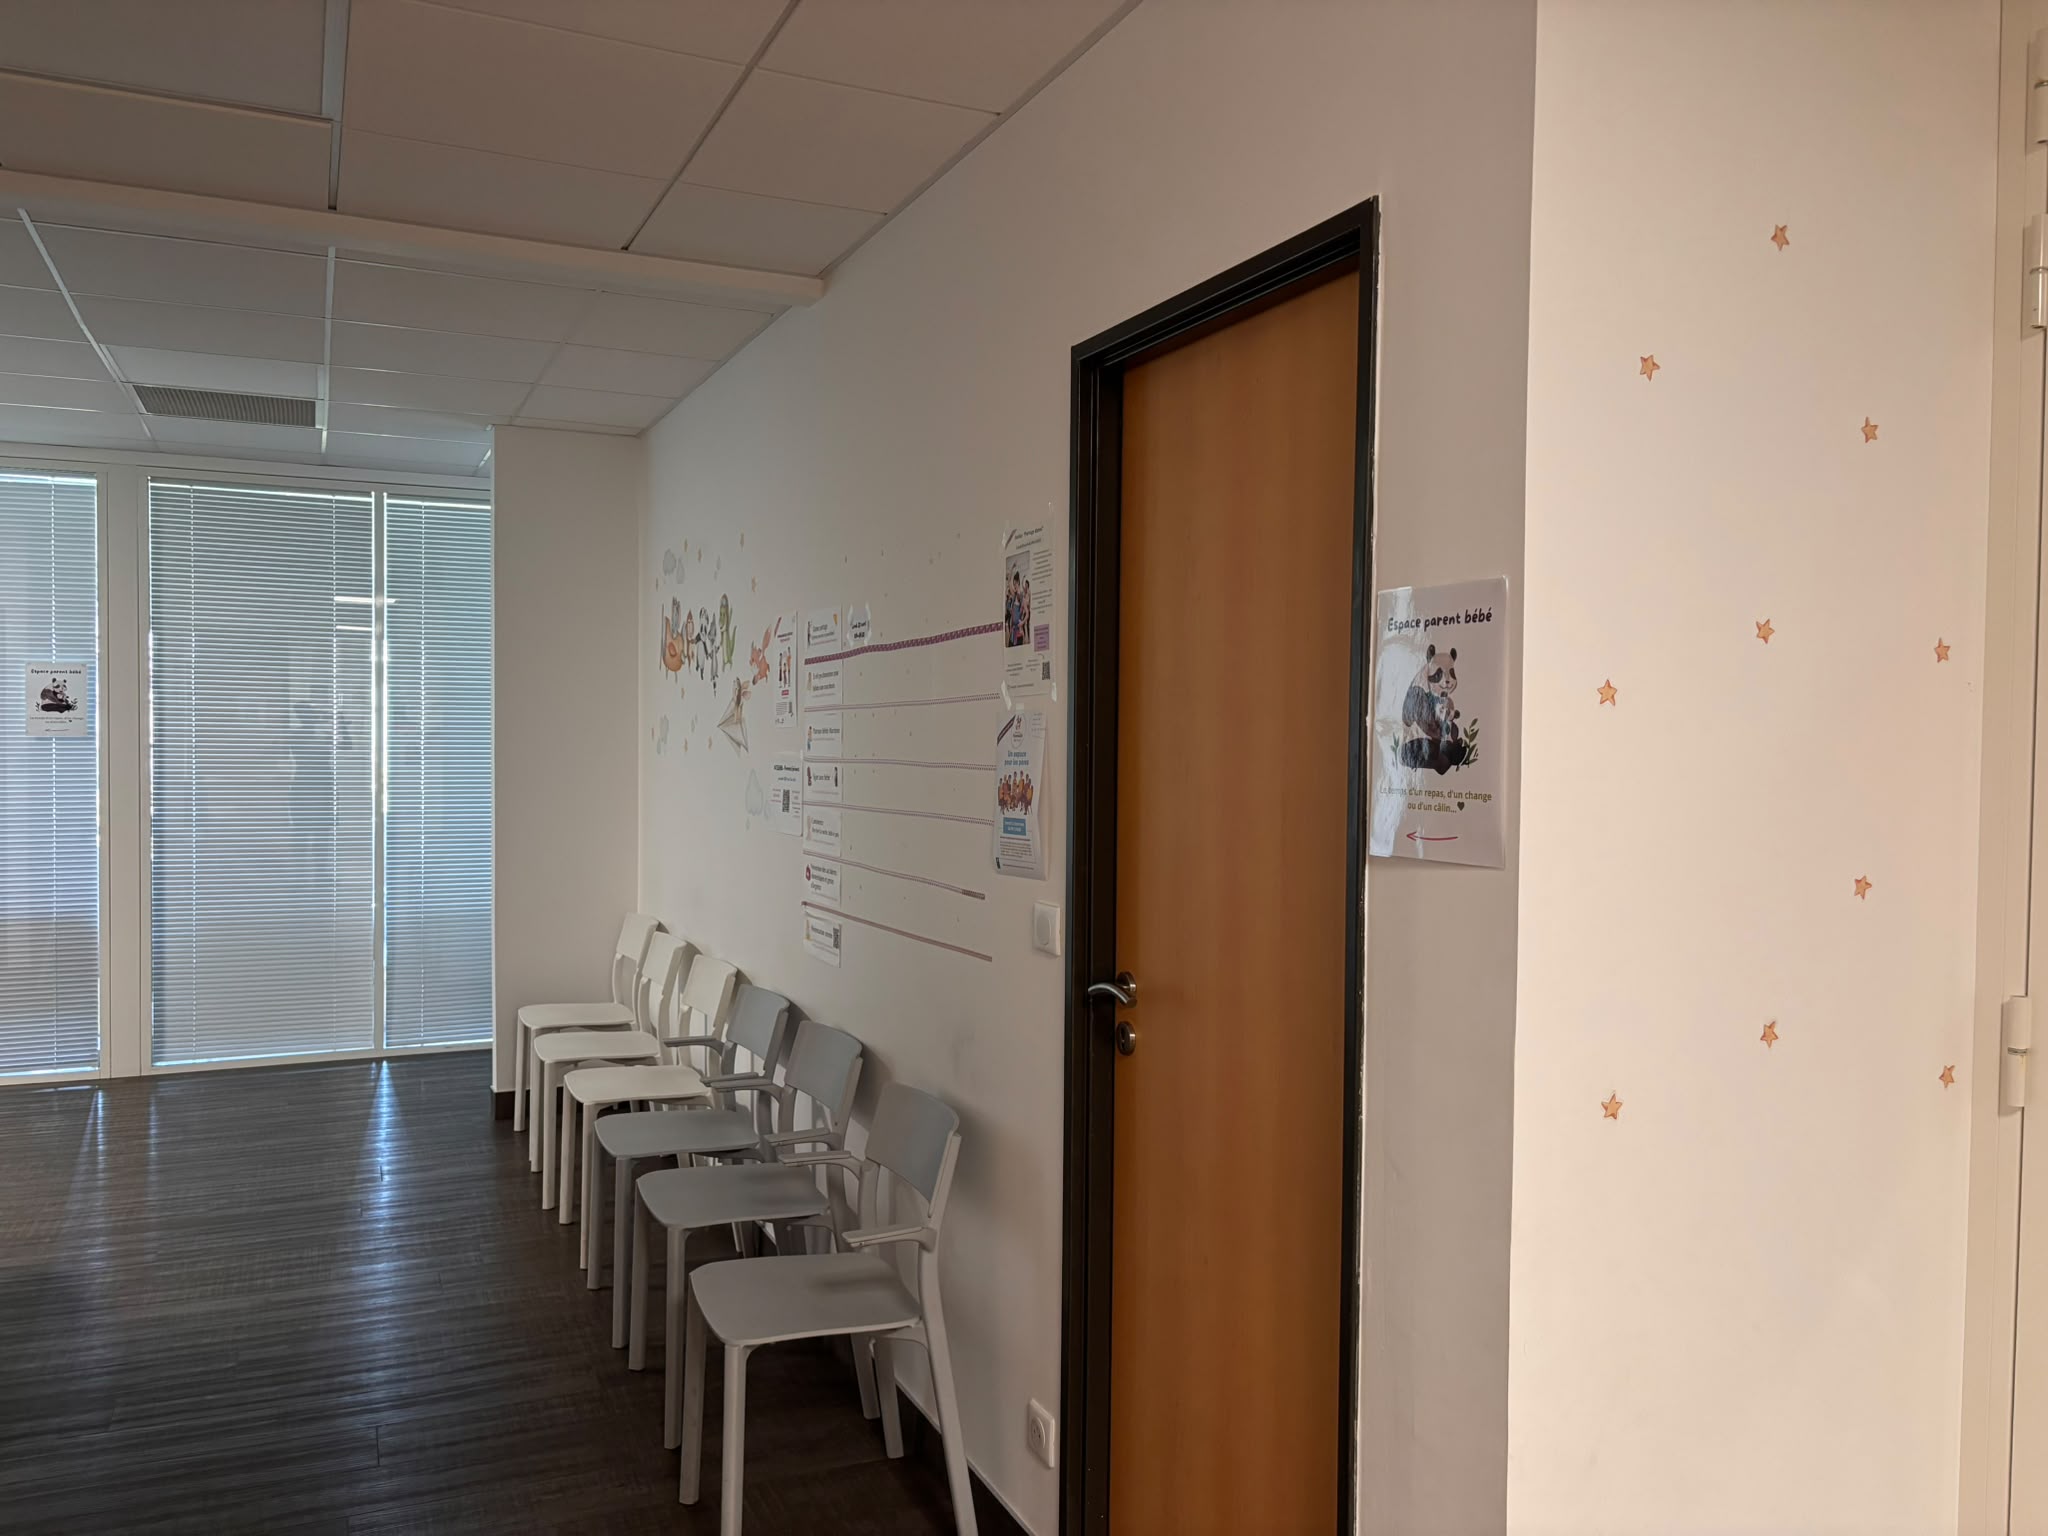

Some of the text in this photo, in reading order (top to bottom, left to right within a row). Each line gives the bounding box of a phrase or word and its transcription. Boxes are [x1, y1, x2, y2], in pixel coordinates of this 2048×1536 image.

[1387, 606, 1493, 634] Espace parent bébé
[1408, 787, 1423, 796] d'un
[1424, 789, 1446, 799] repas,
[1447, 789, 1463, 798] d'un
[1464, 790, 1492, 803] change
[1407, 801, 1457, 813] ou d'un câlin...
